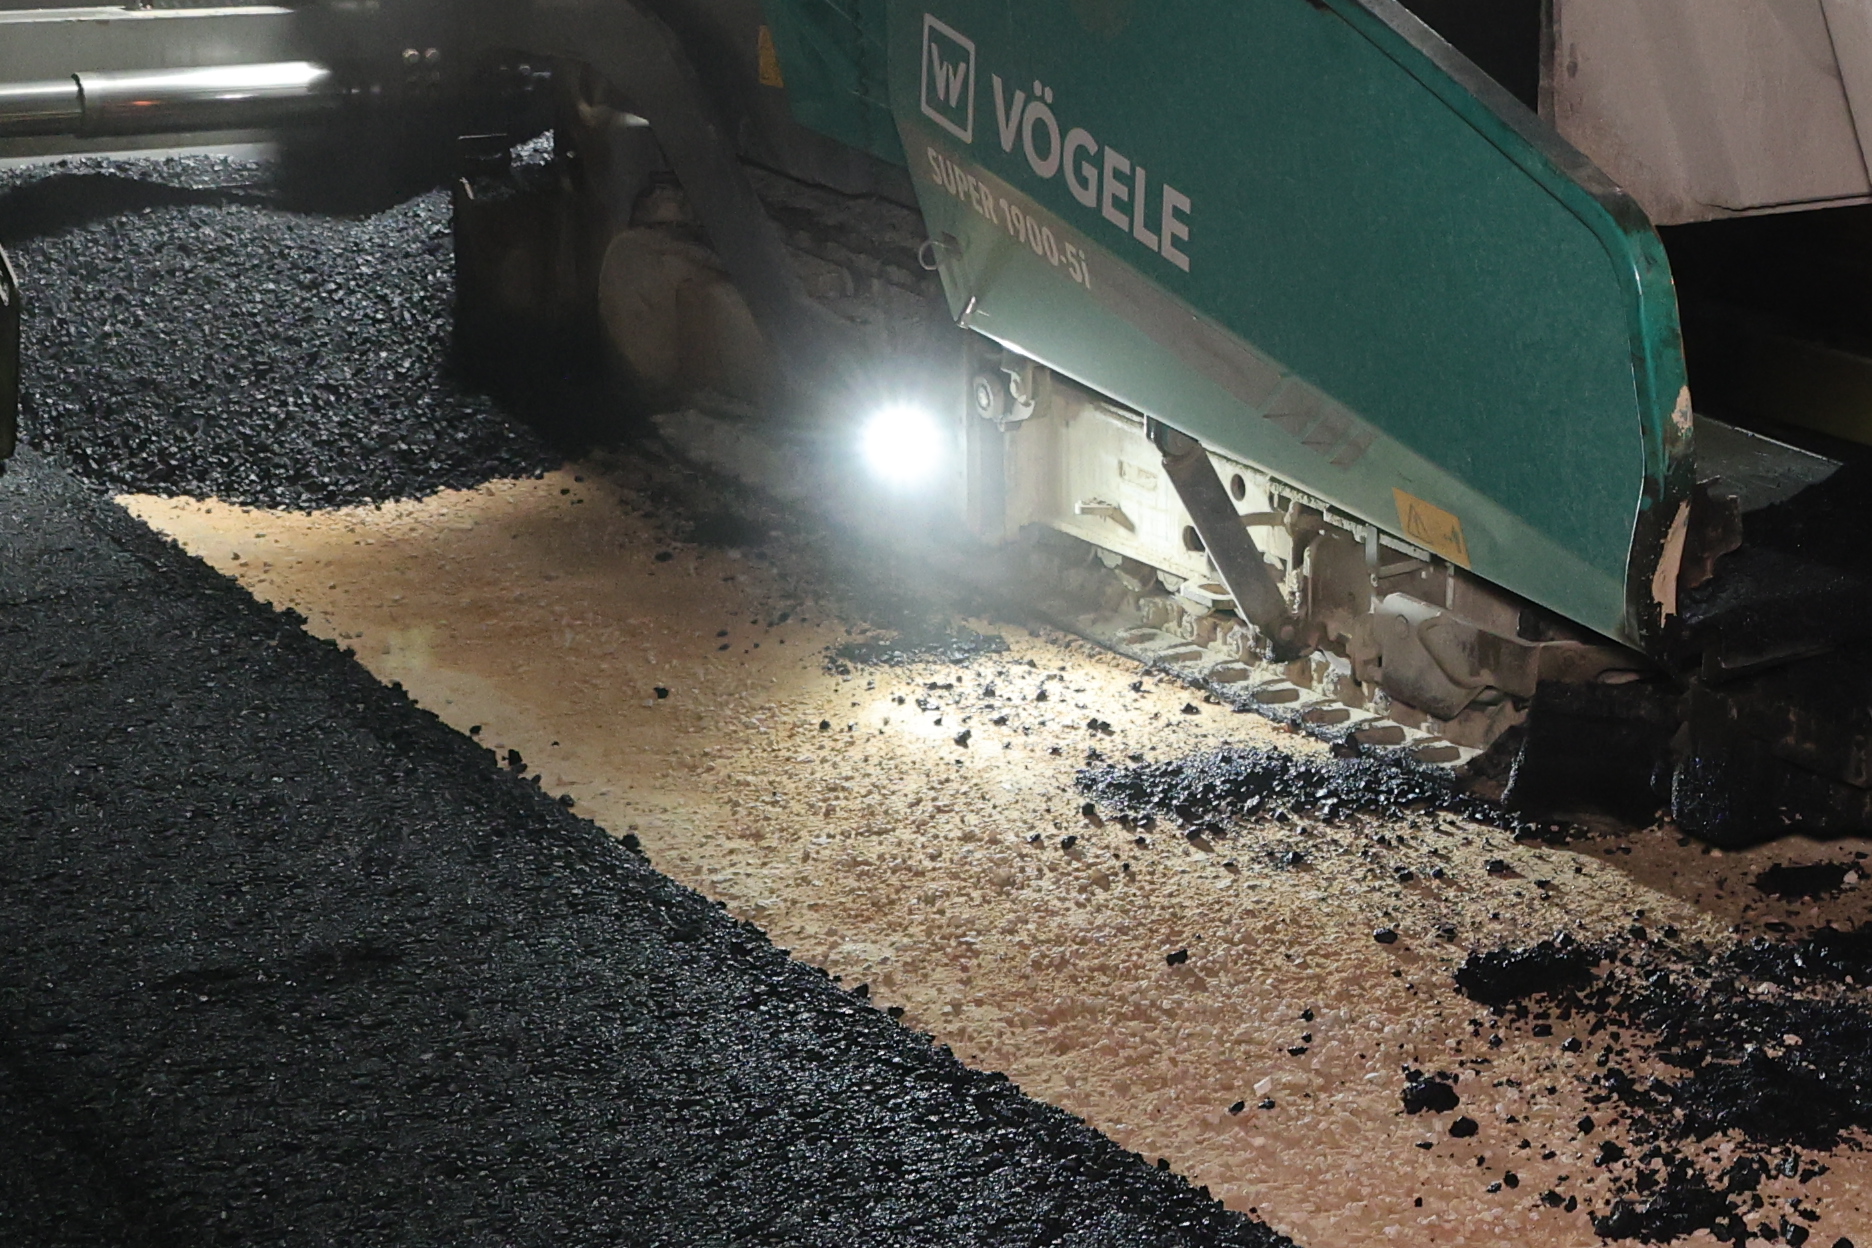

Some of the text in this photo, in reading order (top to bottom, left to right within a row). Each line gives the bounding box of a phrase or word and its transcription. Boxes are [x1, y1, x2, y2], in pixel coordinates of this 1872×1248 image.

[926, 146, 1092, 291] SUPER 1900-5i
[991, 73, 1192, 272] VÖGELE
